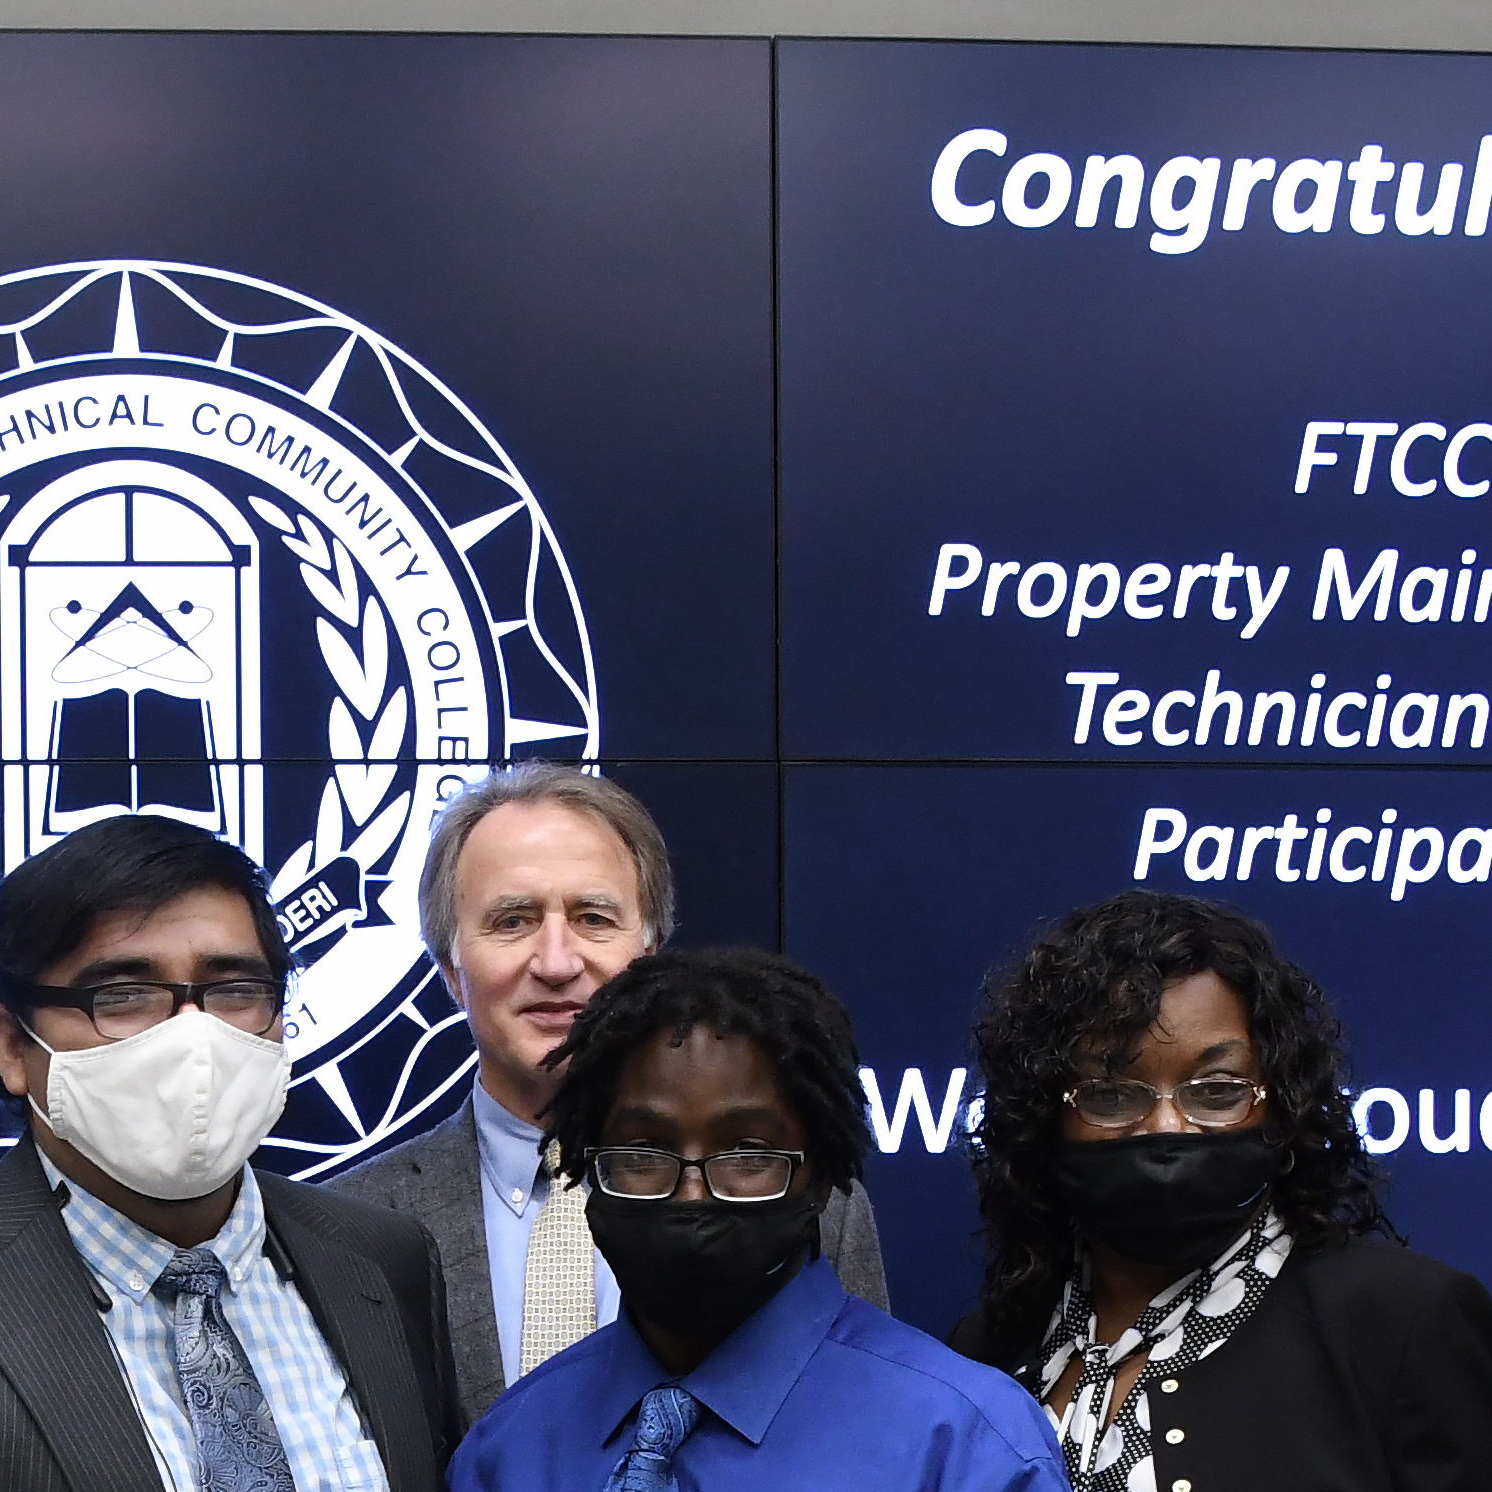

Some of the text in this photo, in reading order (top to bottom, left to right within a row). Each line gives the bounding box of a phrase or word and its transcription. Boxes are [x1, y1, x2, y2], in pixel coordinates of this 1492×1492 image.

[191, 402, 429, 582] COMMUNITY
[416, 607, 470, 830] COLLEG
[928, 543, 1291, 639] Property
[1065, 669, 1490, 749] Technician
